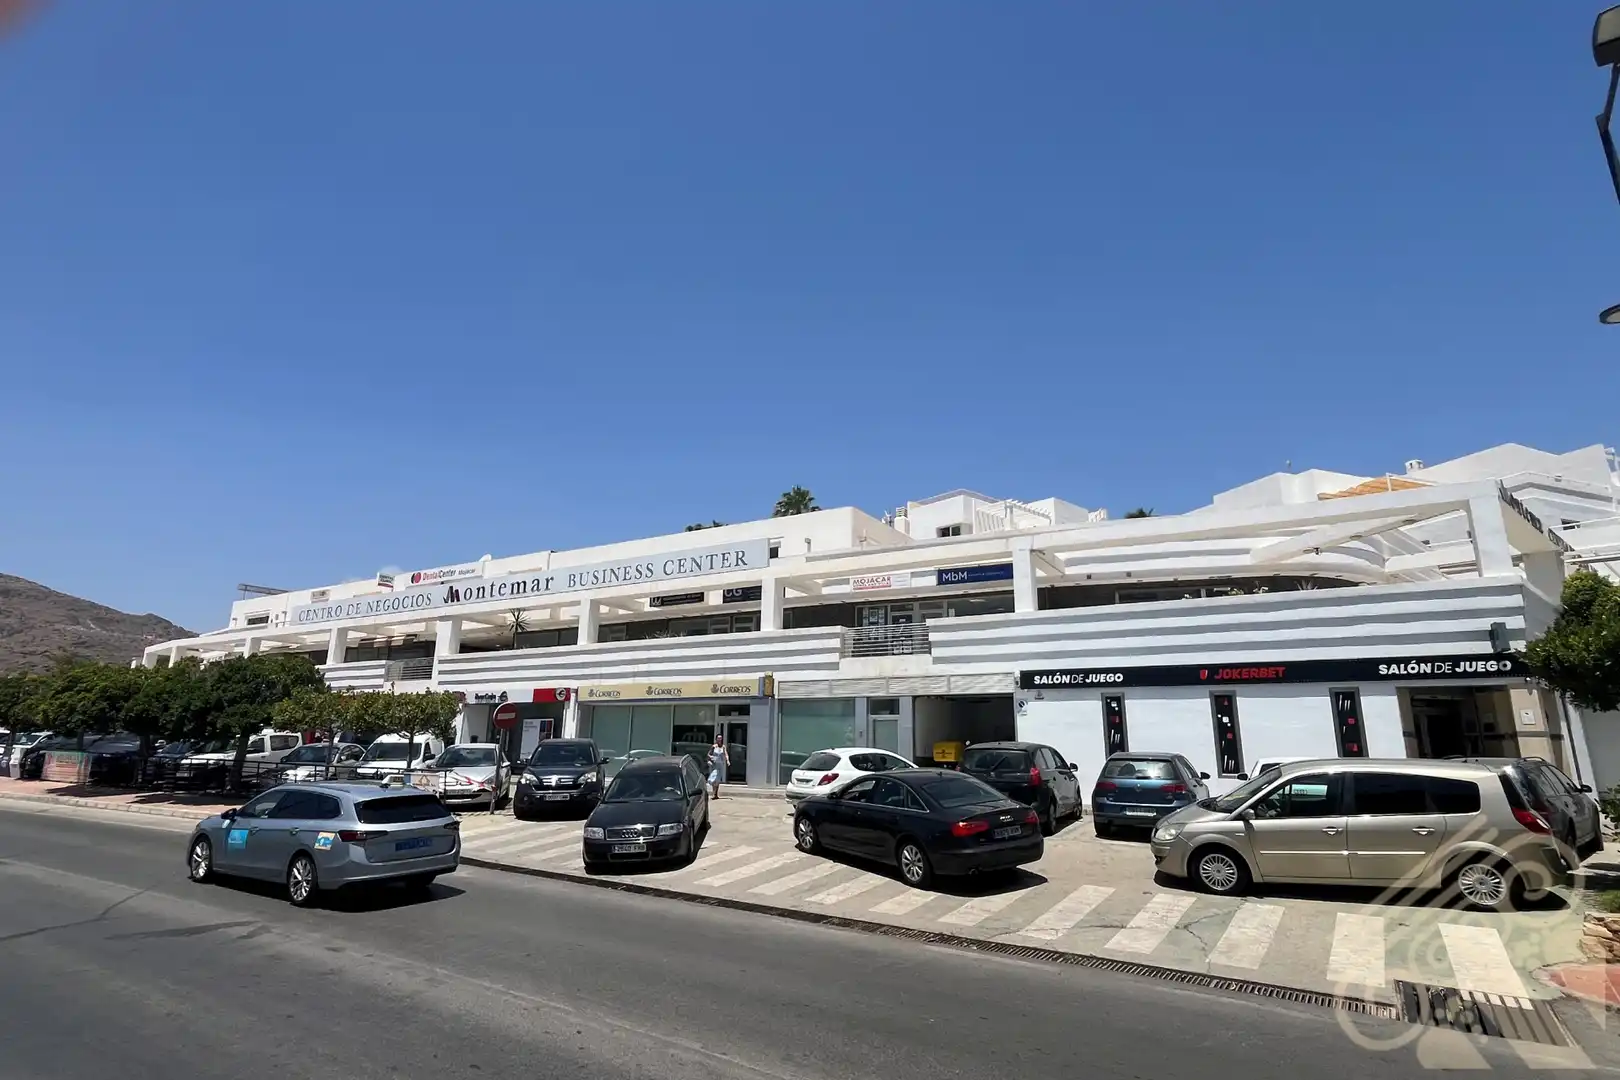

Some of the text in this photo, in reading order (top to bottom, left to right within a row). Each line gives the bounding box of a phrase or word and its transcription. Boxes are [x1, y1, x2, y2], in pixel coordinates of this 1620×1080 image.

[942, 571, 968, 582] MbM
[298, 550, 748, 622] CENTRO DE NEGOCIOS Montemar BUSINESS CENTER
[1214, 666, 1286, 679] JOKERBET
[1379, 660, 1512, 675] SALÓN DE JUEGO
[1033, 672, 1124, 685] SALÓN DE JUEGO
